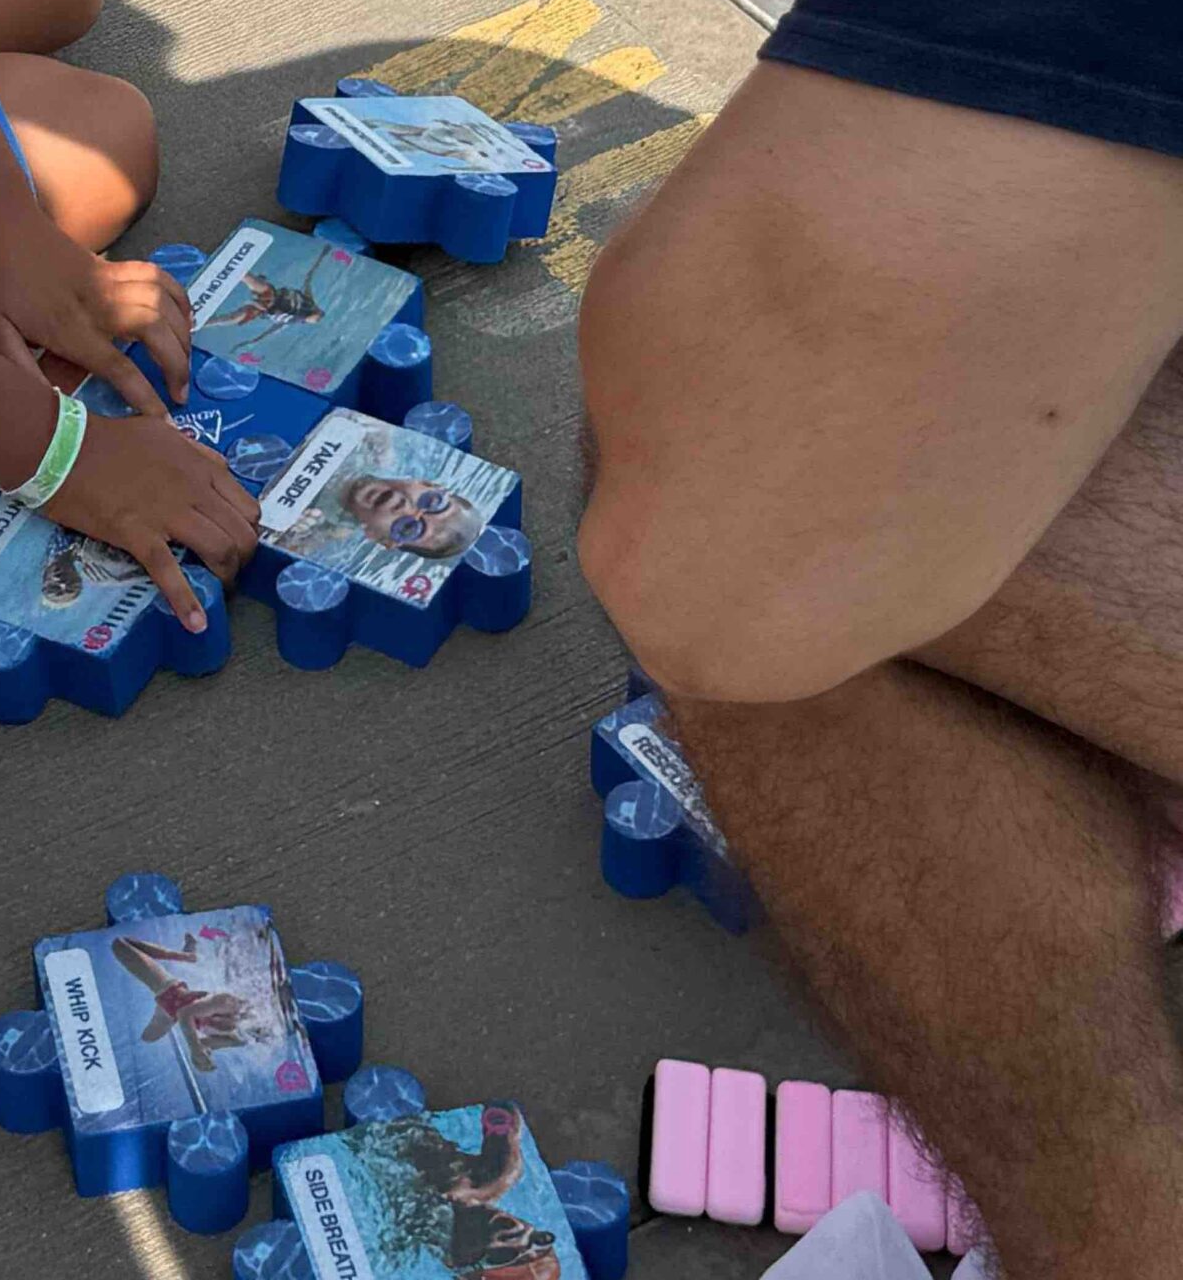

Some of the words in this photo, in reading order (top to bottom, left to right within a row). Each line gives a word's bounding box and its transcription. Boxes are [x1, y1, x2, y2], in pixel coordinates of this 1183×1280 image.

[191, 291, 213, 318] BAC
[303, 441, 342, 476] TAKE
[277, 474, 312, 508] SIDE
[64, 976, 91, 1022] WHIP
[76, 1027, 103, 1071] KICK
[305, 1168, 334, 1213] SIDE
